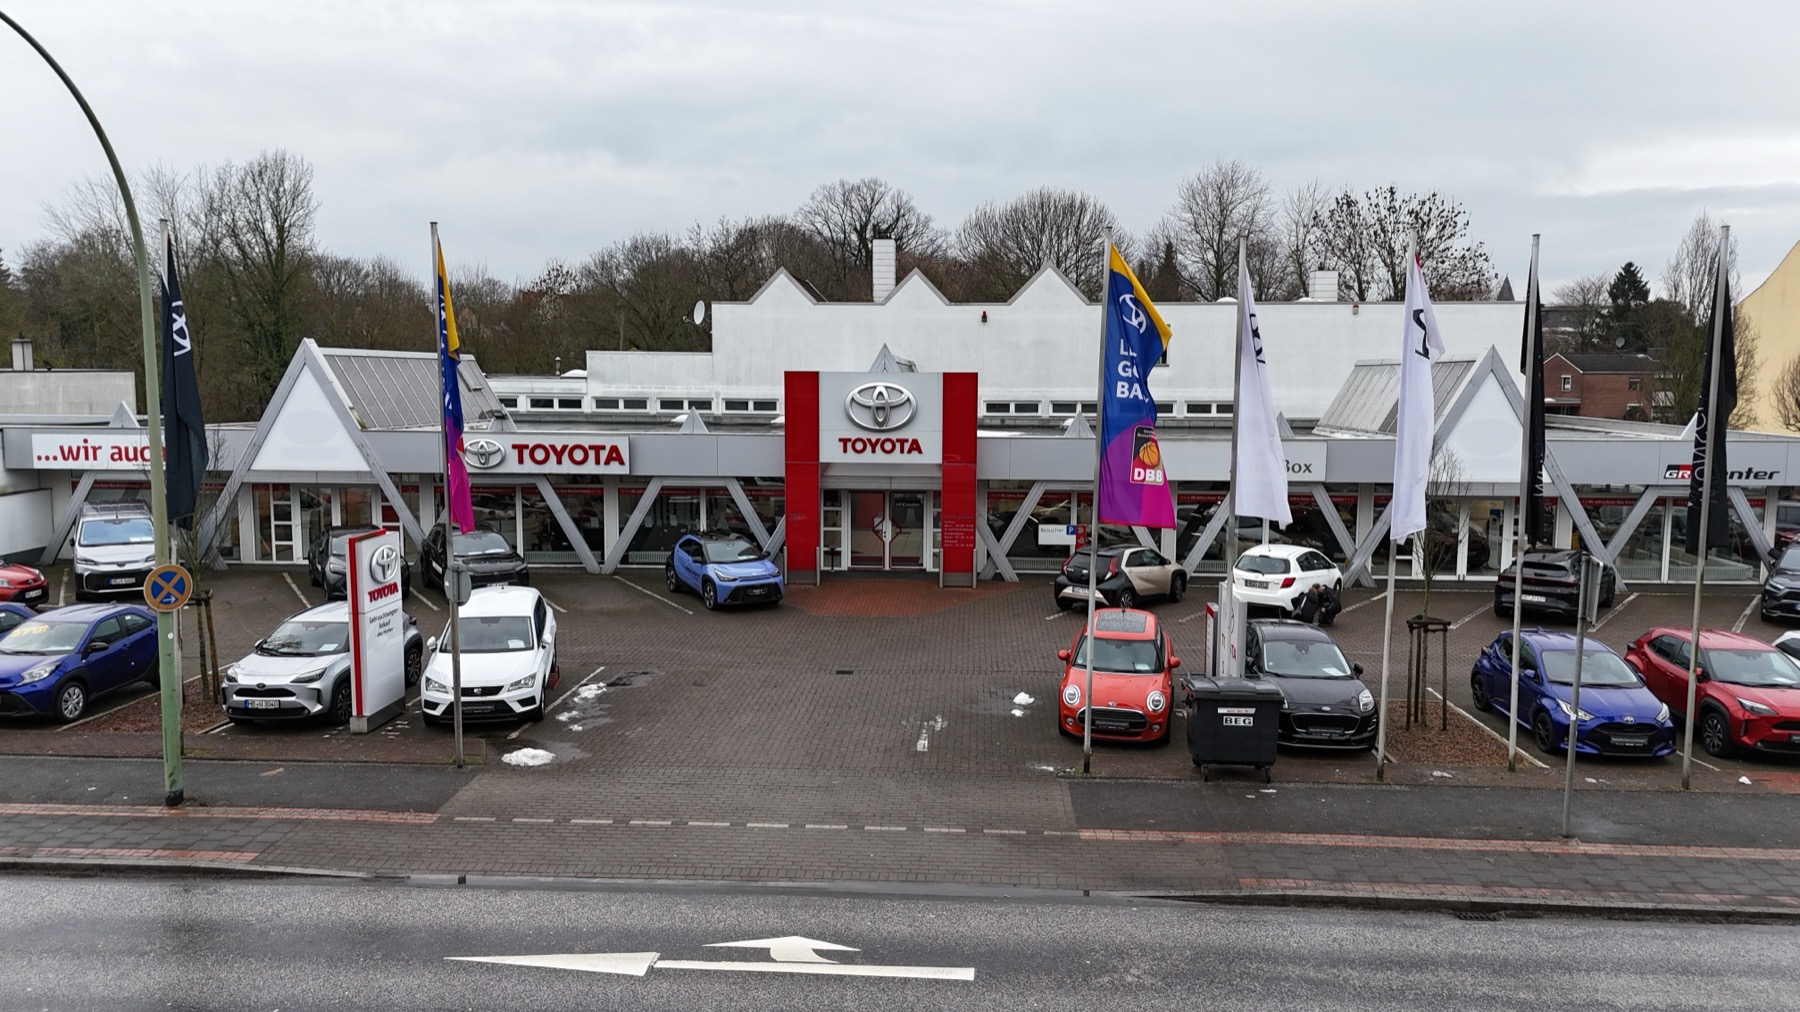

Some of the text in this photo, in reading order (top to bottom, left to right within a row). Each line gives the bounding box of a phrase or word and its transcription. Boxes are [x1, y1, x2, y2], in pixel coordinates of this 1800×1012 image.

[110, 444, 167, 463] auc
[512, 443, 626, 466] TOYOTA
[837, 437, 924, 455] TOYOTA
[368, 581, 399, 603] TOYOTA
[1224, 716, 1252, 726] BEG
